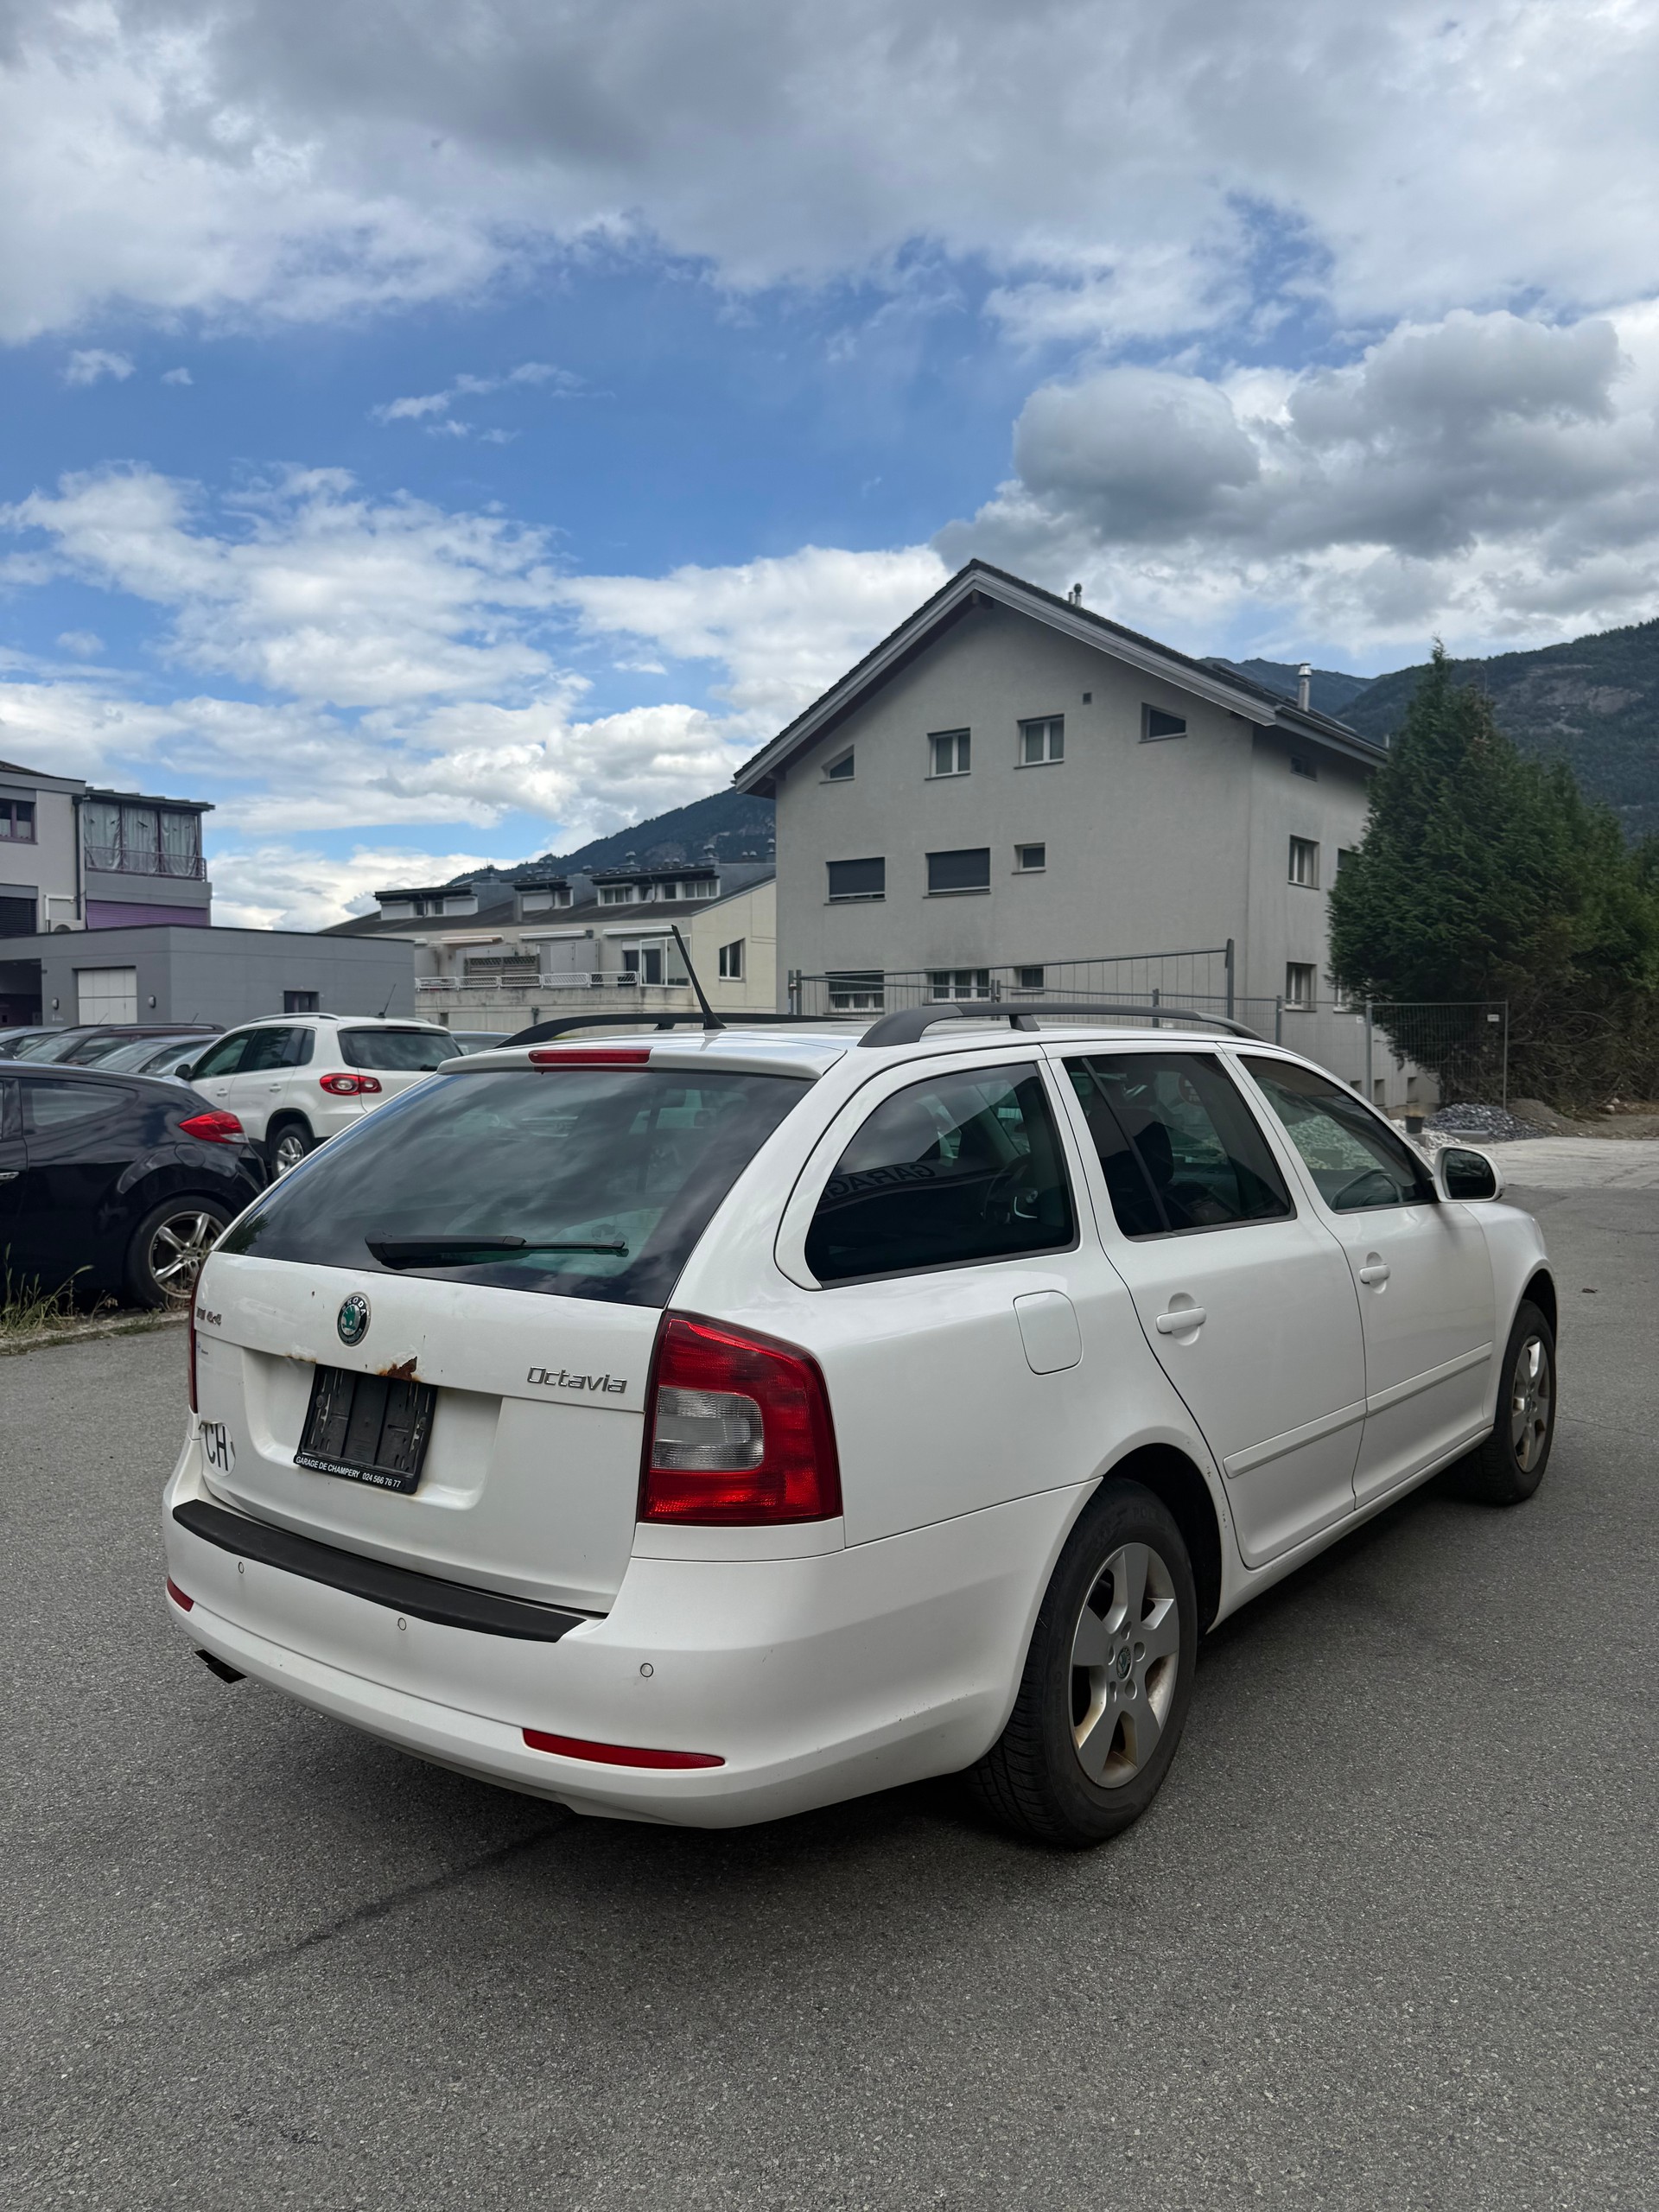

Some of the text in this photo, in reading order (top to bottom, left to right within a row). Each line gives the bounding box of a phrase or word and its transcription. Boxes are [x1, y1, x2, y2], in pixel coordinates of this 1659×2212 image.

[527, 1366, 627, 1393] Octavia
[205, 1423, 229, 1471] CH
[296, 1456, 319, 1468] GARAGE
[318, 1462, 327, 1471] DE
[327, 1464, 359, 1478] CHAMPERY
[362, 1472, 373, 1481] 024
[372, 1475, 385, 1484] 566
